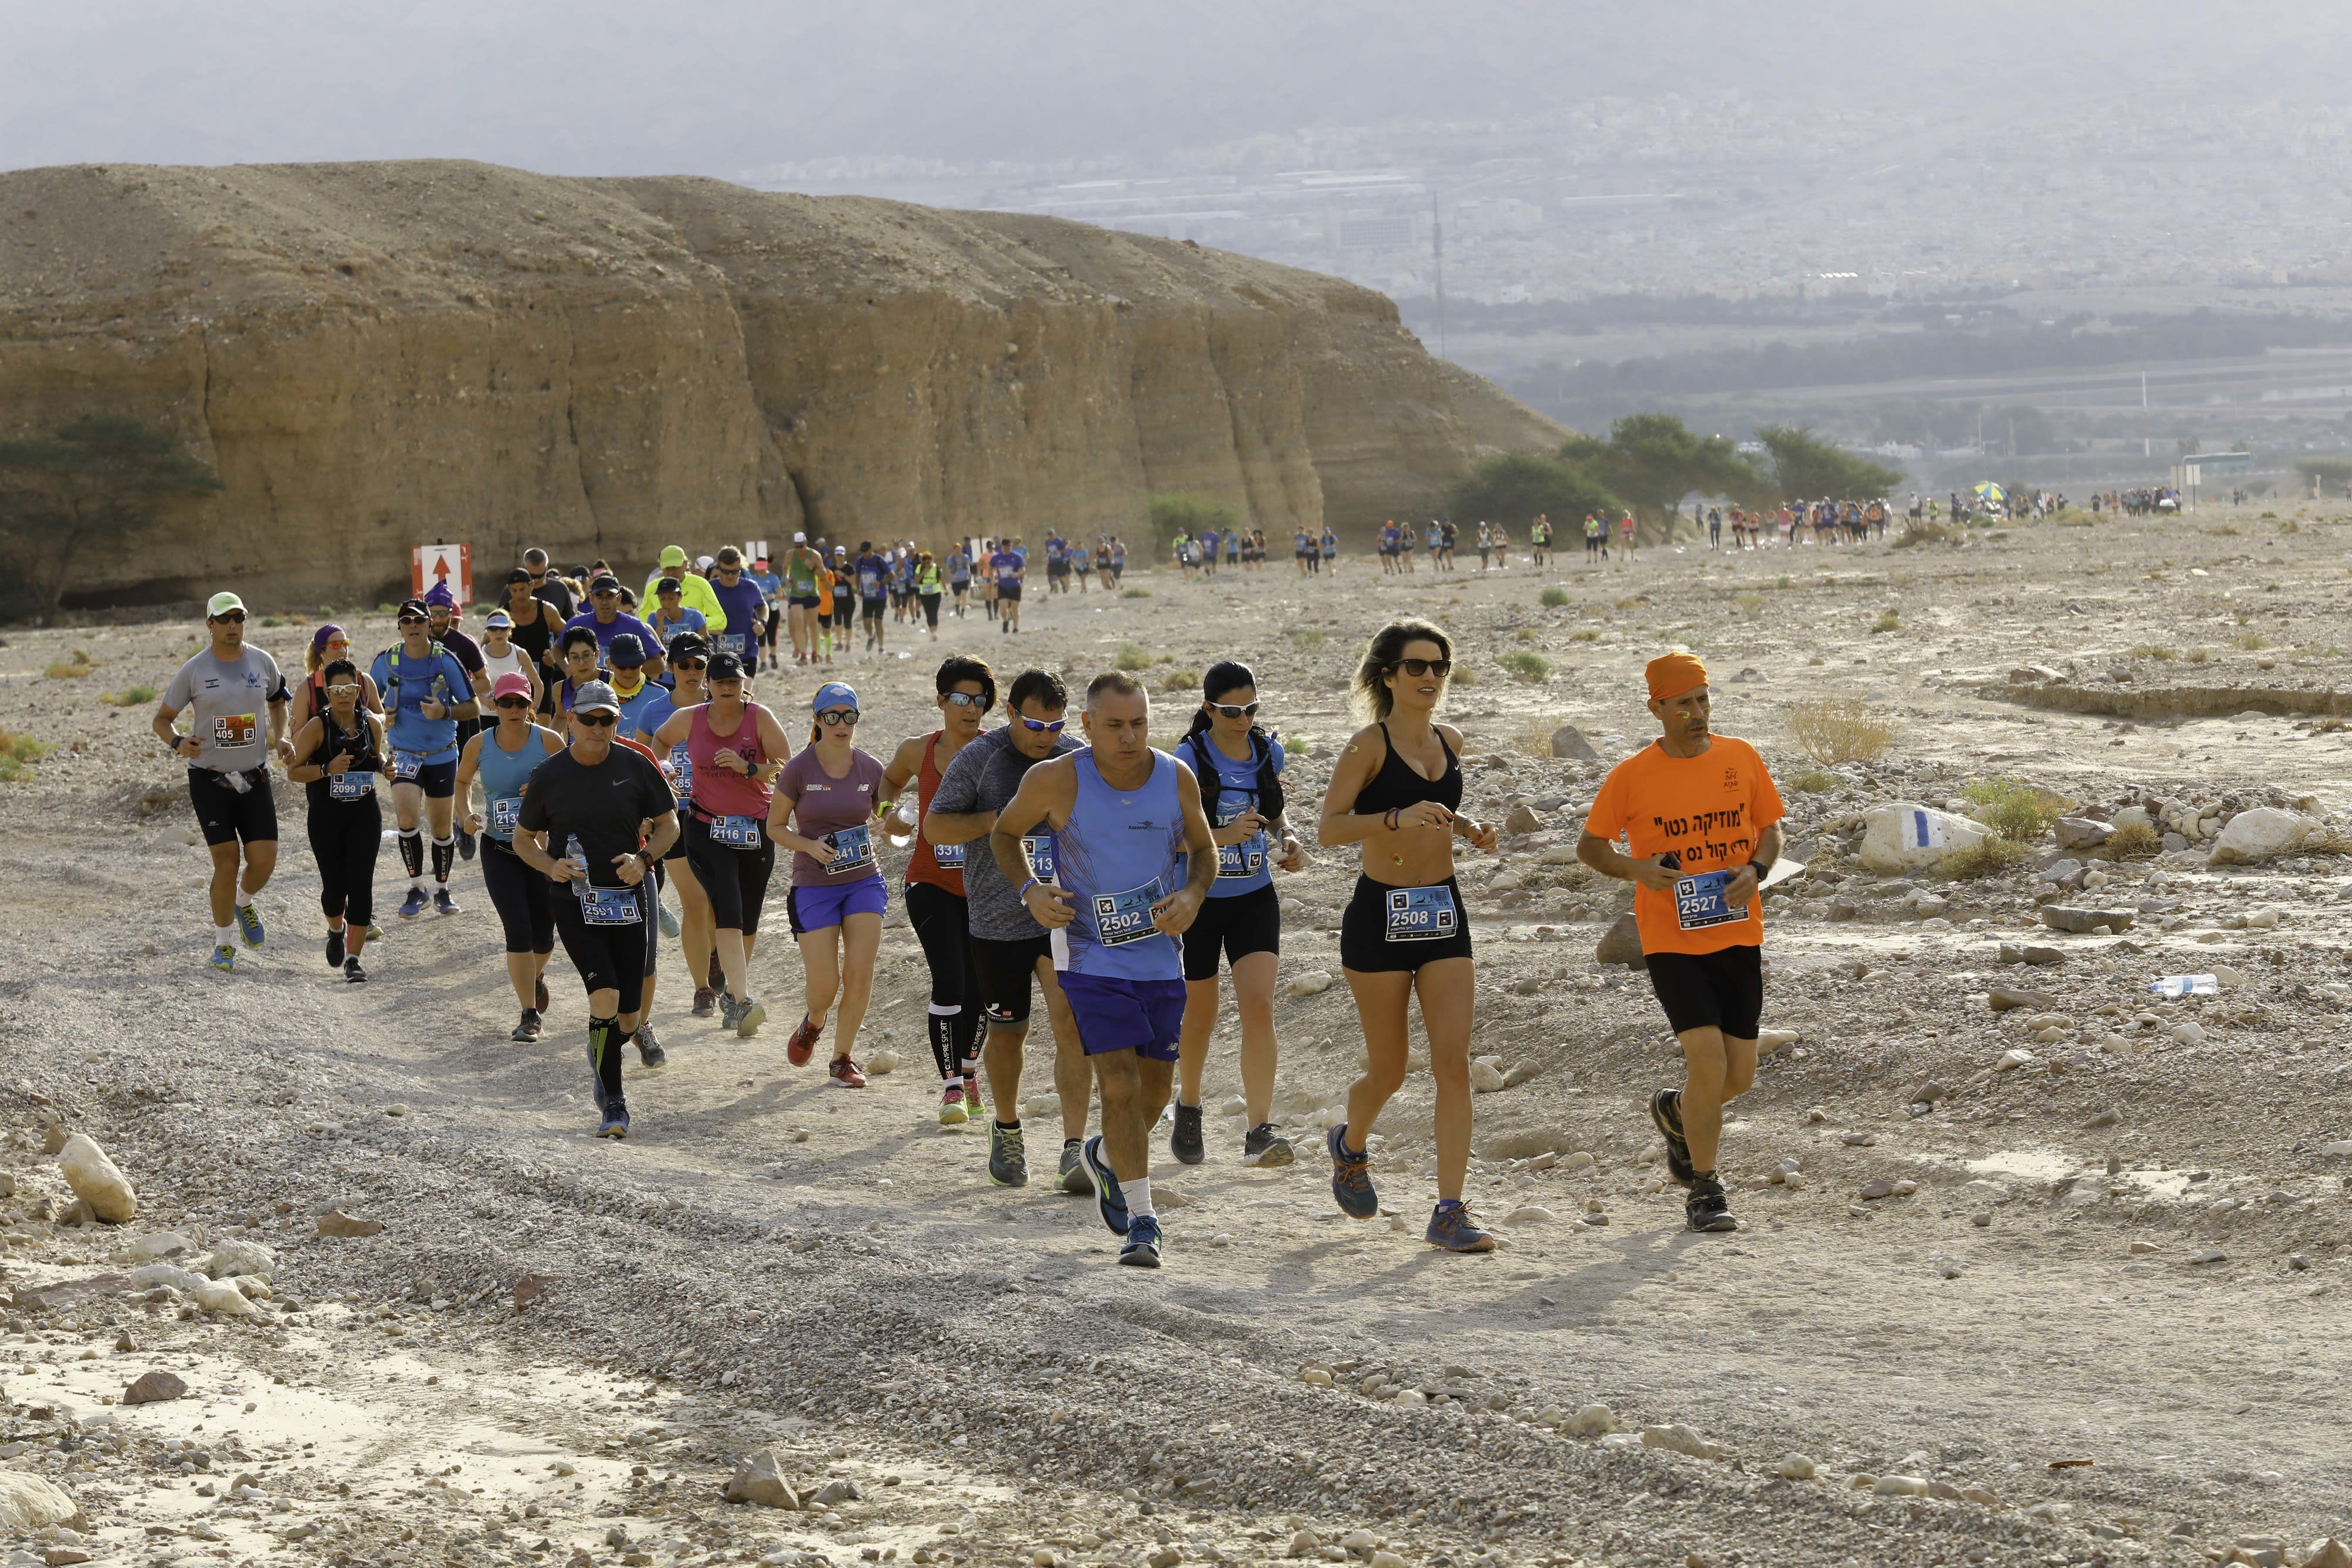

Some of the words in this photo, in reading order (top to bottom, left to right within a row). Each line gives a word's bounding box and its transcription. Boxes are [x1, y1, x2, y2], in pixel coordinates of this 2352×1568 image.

[216, 730, 233, 739] 405
[332, 784, 356, 793] 2099
[673, 778, 693, 789] 285
[496, 813, 519, 824] 213
[713, 829, 739, 840] 2116
[833, 846, 854, 862] 841
[1686, 846, 1703, 861] נס
[1706, 840, 1727, 861] קול
[1028, 857, 1053, 871] 313
[1220, 852, 1241, 865] 300
[584, 905, 613, 916] 2591
[1681, 895, 1718, 914] 2527
[1100, 912, 1142, 931] 2502
[1391, 911, 1428, 927] 2508
[589, 1017, 602, 1025] ep
